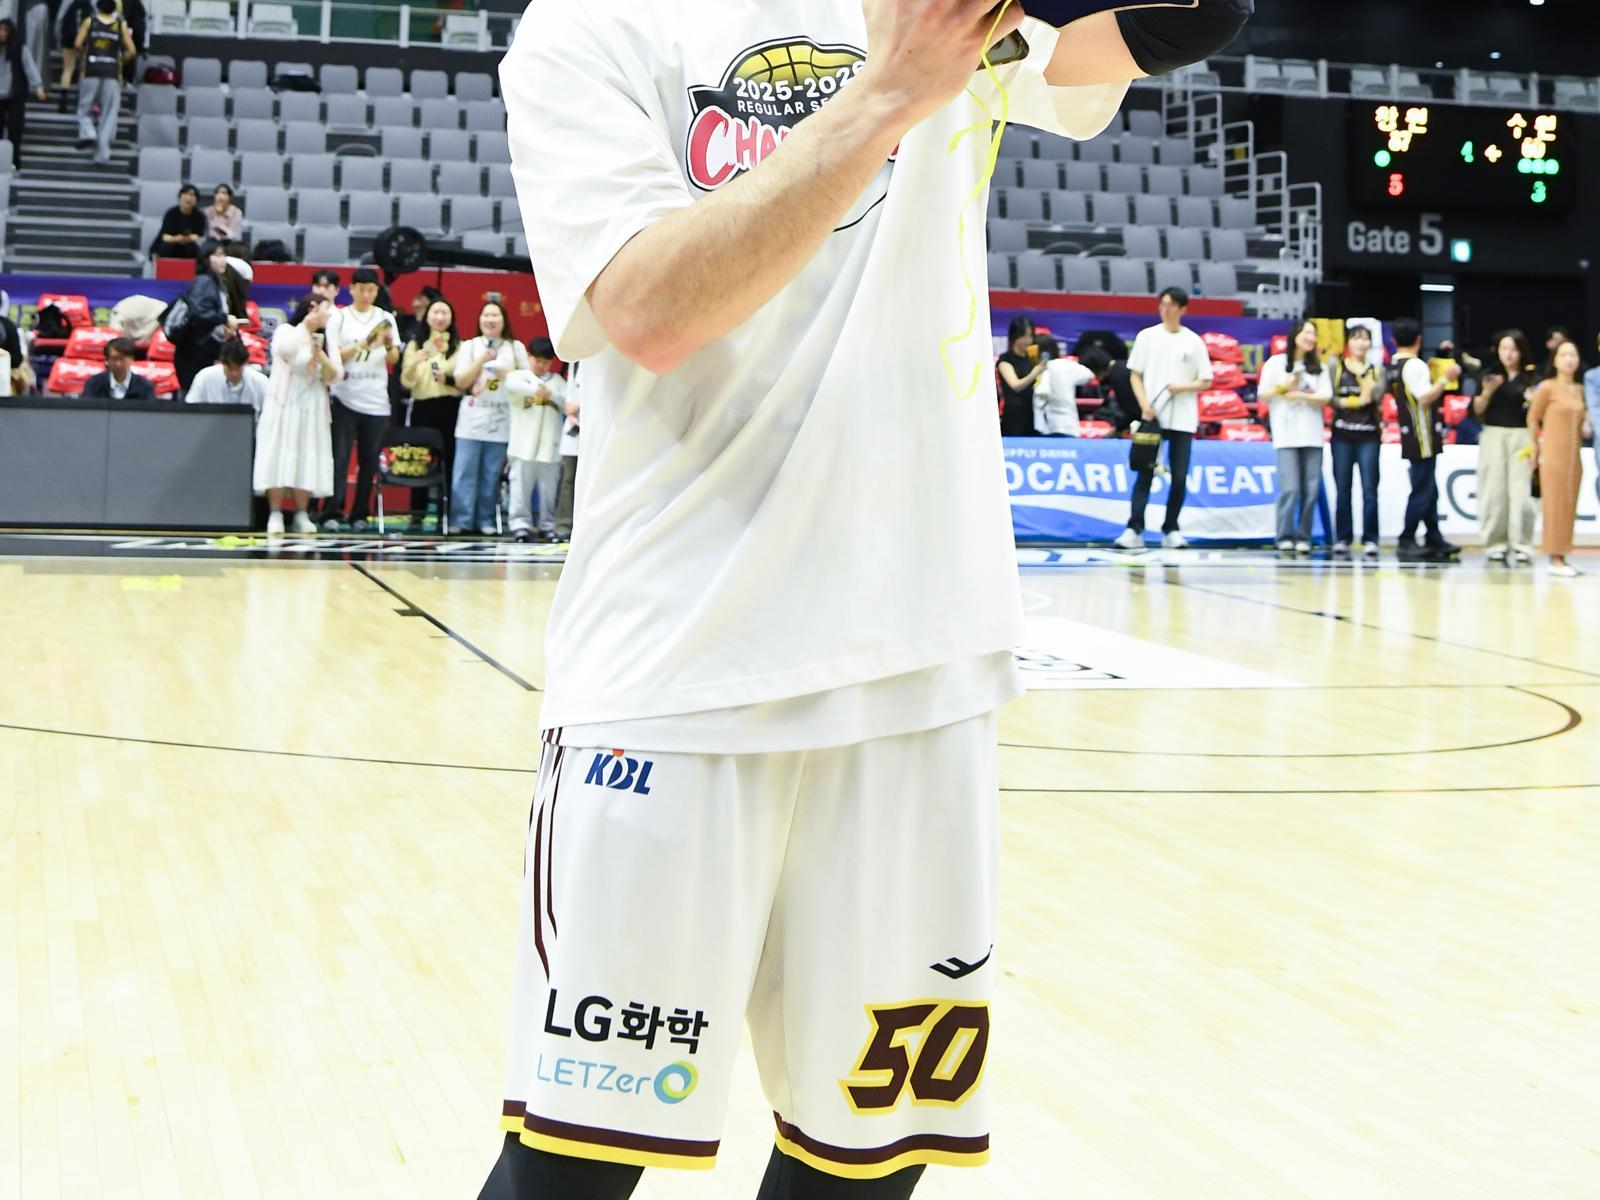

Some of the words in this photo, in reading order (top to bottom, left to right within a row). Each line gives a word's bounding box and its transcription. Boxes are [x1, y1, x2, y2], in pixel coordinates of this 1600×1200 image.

[737, 99, 806, 116] REGULAR
[1388, 173, 1404, 196] 5
[1530, 180, 1547, 203] 3
[1347, 220, 1411, 254] Gate
[1418, 213, 1444, 256] 5
[583, 750, 655, 796] KBL
[543, 987, 710, 1055] LG화학
[837, 998, 991, 1116] 50
